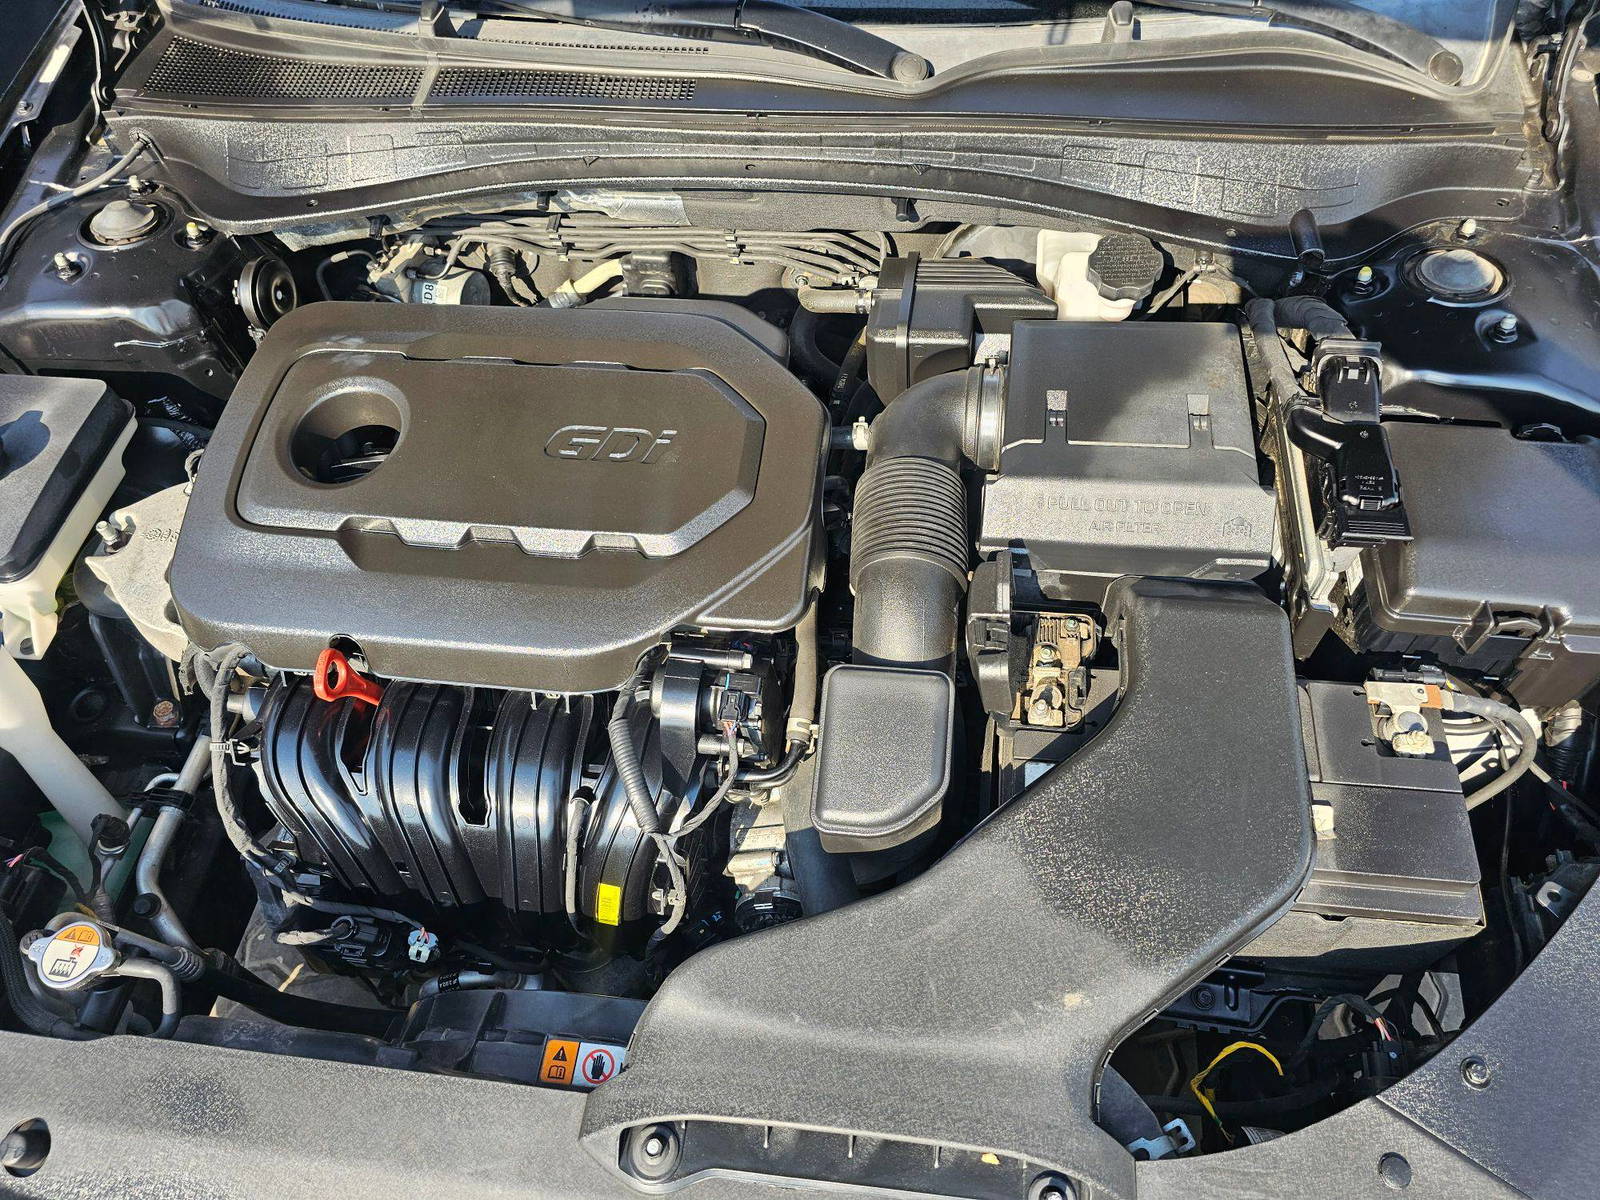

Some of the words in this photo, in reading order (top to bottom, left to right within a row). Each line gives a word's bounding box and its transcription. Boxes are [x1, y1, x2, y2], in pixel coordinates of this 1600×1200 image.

[1047, 495, 1089, 512] PULL
[1094, 498, 1128, 513] OUT
[1134, 499, 1156, 515] TO
[1160, 501, 1208, 517] OPEN
[1088, 520, 1113, 532] AIR
[1115, 521, 1161, 534] FILTER
